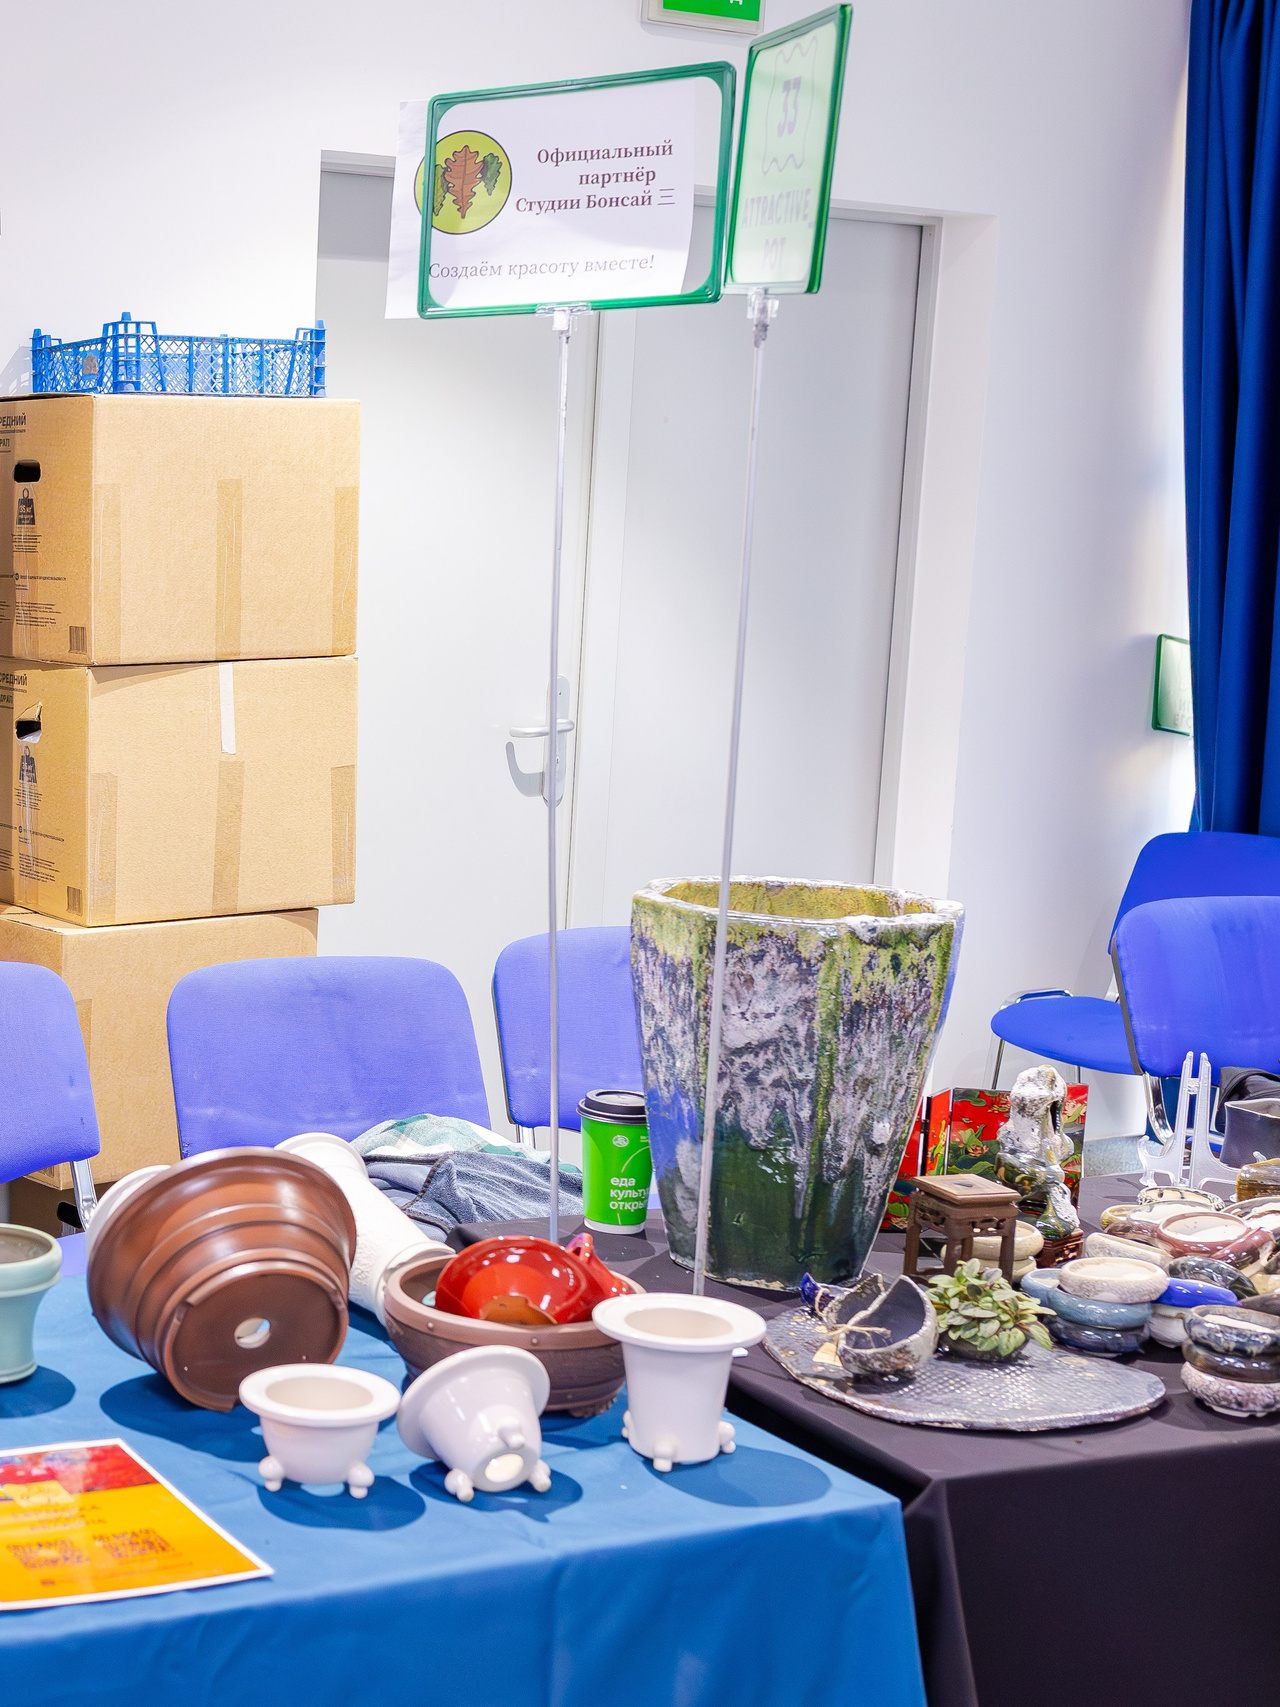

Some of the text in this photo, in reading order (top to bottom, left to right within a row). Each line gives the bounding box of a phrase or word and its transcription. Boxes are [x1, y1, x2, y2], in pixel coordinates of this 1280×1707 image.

[537, 139, 674, 167] Официальный
[578, 166, 656, 188] партнёр
[516, 196, 581, 215] Студии
[586, 189, 653, 209] Бонсай
[428, 254, 655, 280] Создаём красоту вместе!
[610, 1176, 636, 1187] еда
